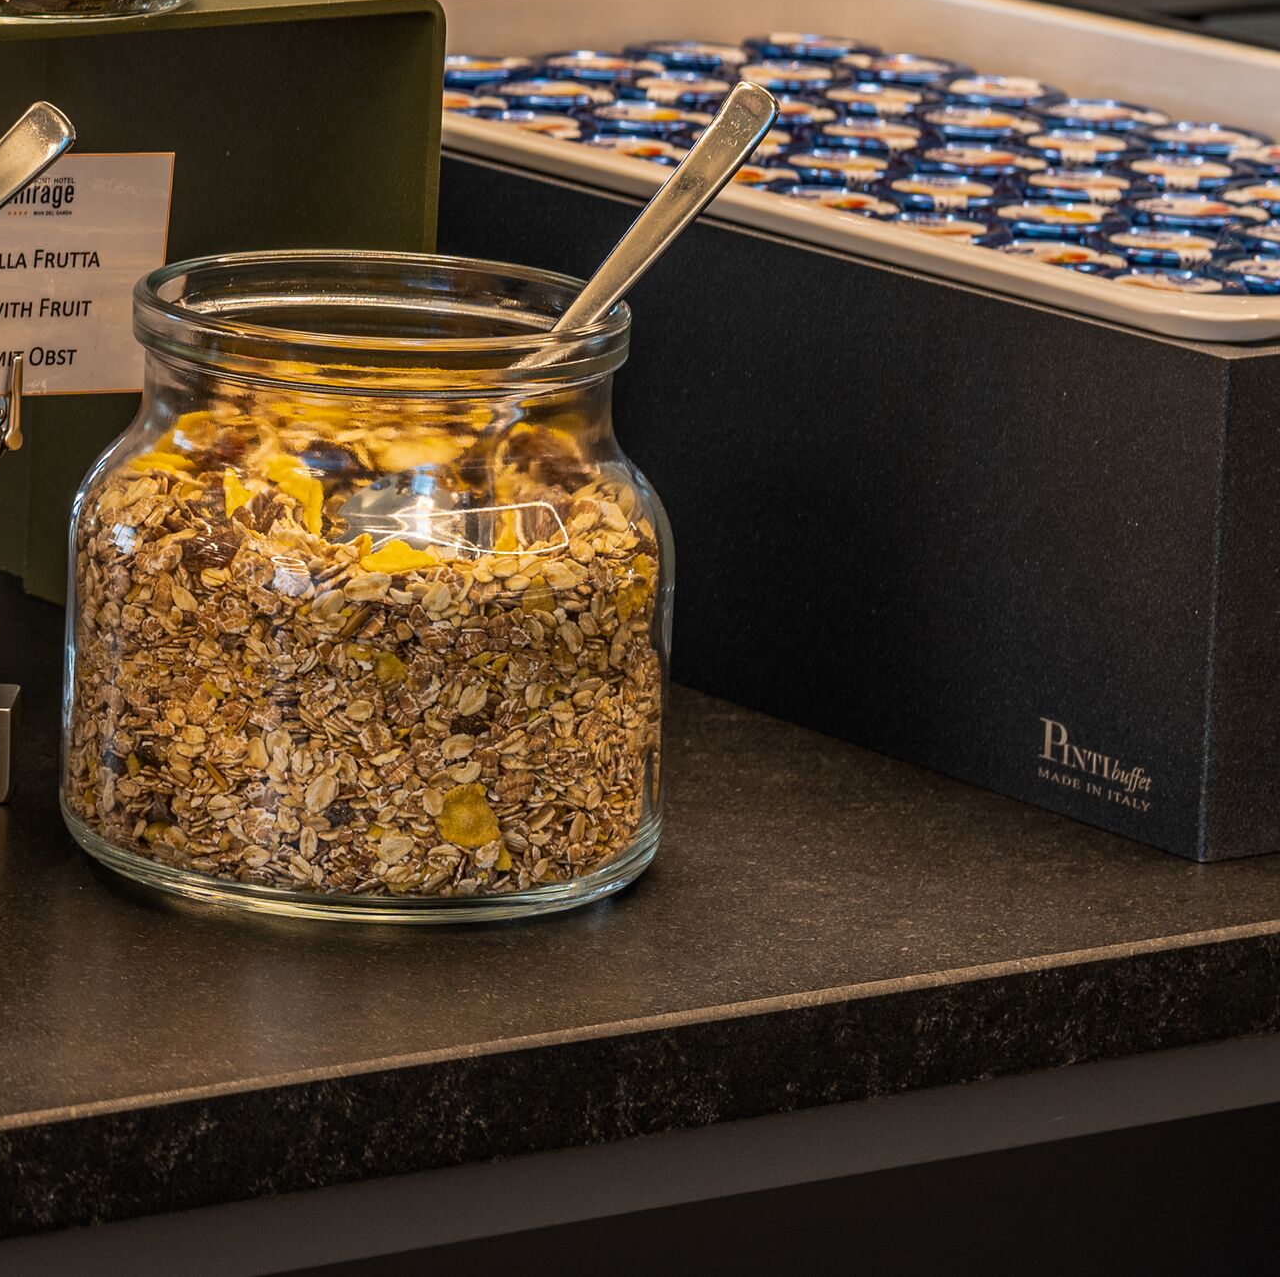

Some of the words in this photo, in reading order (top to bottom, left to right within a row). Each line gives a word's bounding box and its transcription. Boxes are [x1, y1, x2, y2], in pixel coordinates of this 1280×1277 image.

[1038, 766, 1081, 790] MADE
[1086, 782, 1102, 797] IN
[1107, 789, 1151, 812] ITALY
